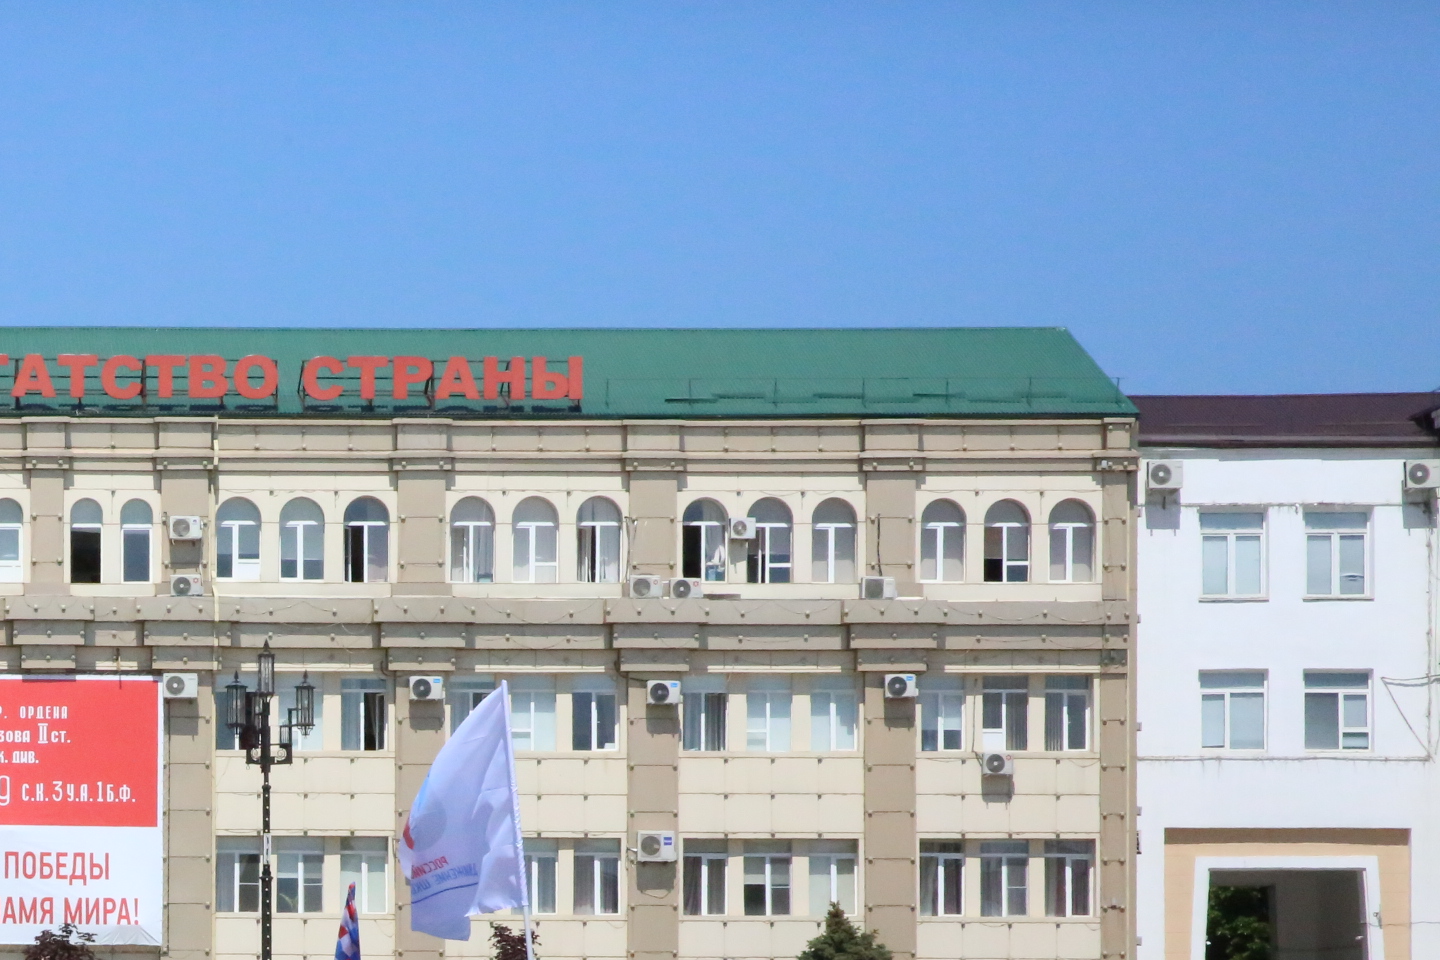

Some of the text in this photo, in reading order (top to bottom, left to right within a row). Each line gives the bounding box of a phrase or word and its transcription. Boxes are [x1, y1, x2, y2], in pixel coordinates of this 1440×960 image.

[301, 355, 584, 401] СТРАНЫ
[19, 705, 68, 719] ОРДЕНА
[4, 851, 110, 886] ПОБЕДЫ
[64, 896, 139, 925] МИРА!
